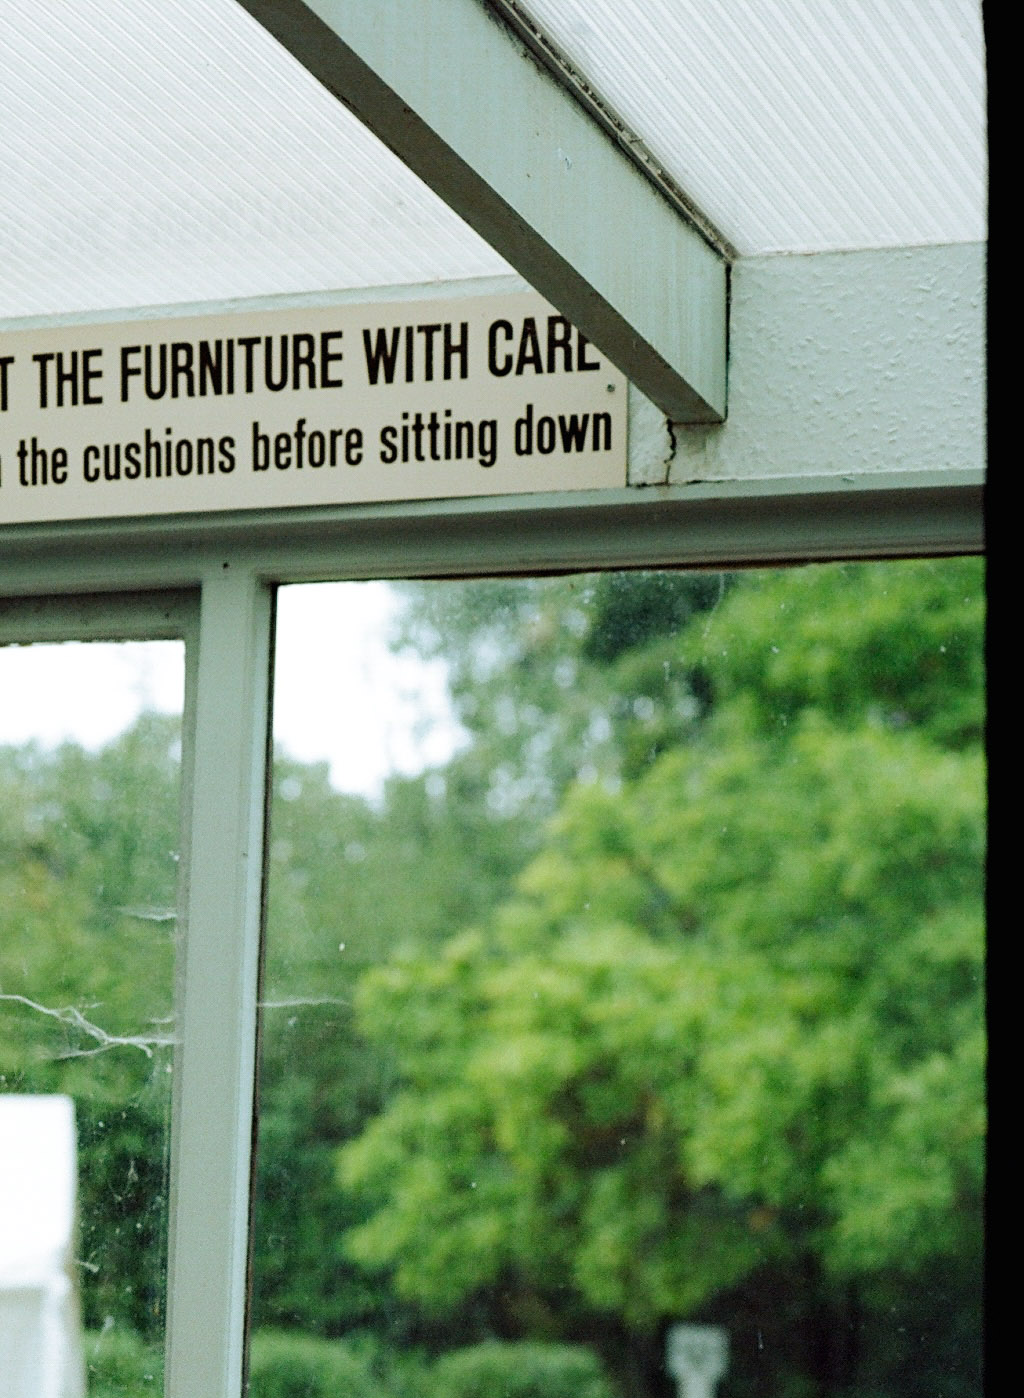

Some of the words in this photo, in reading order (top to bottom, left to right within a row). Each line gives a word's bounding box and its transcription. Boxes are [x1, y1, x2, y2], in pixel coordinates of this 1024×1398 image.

[32, 349, 103, 408] THE
[120, 331, 343, 402] FURNITURE
[363, 322, 468, 385] WITH
[488, 316, 601, 377] CARE
[17, 436, 68, 486] the
[83, 427, 236, 482] cushions
[252, 418, 363, 472] before
[380, 409, 497, 467] sitting
[515, 403, 612, 456] down
